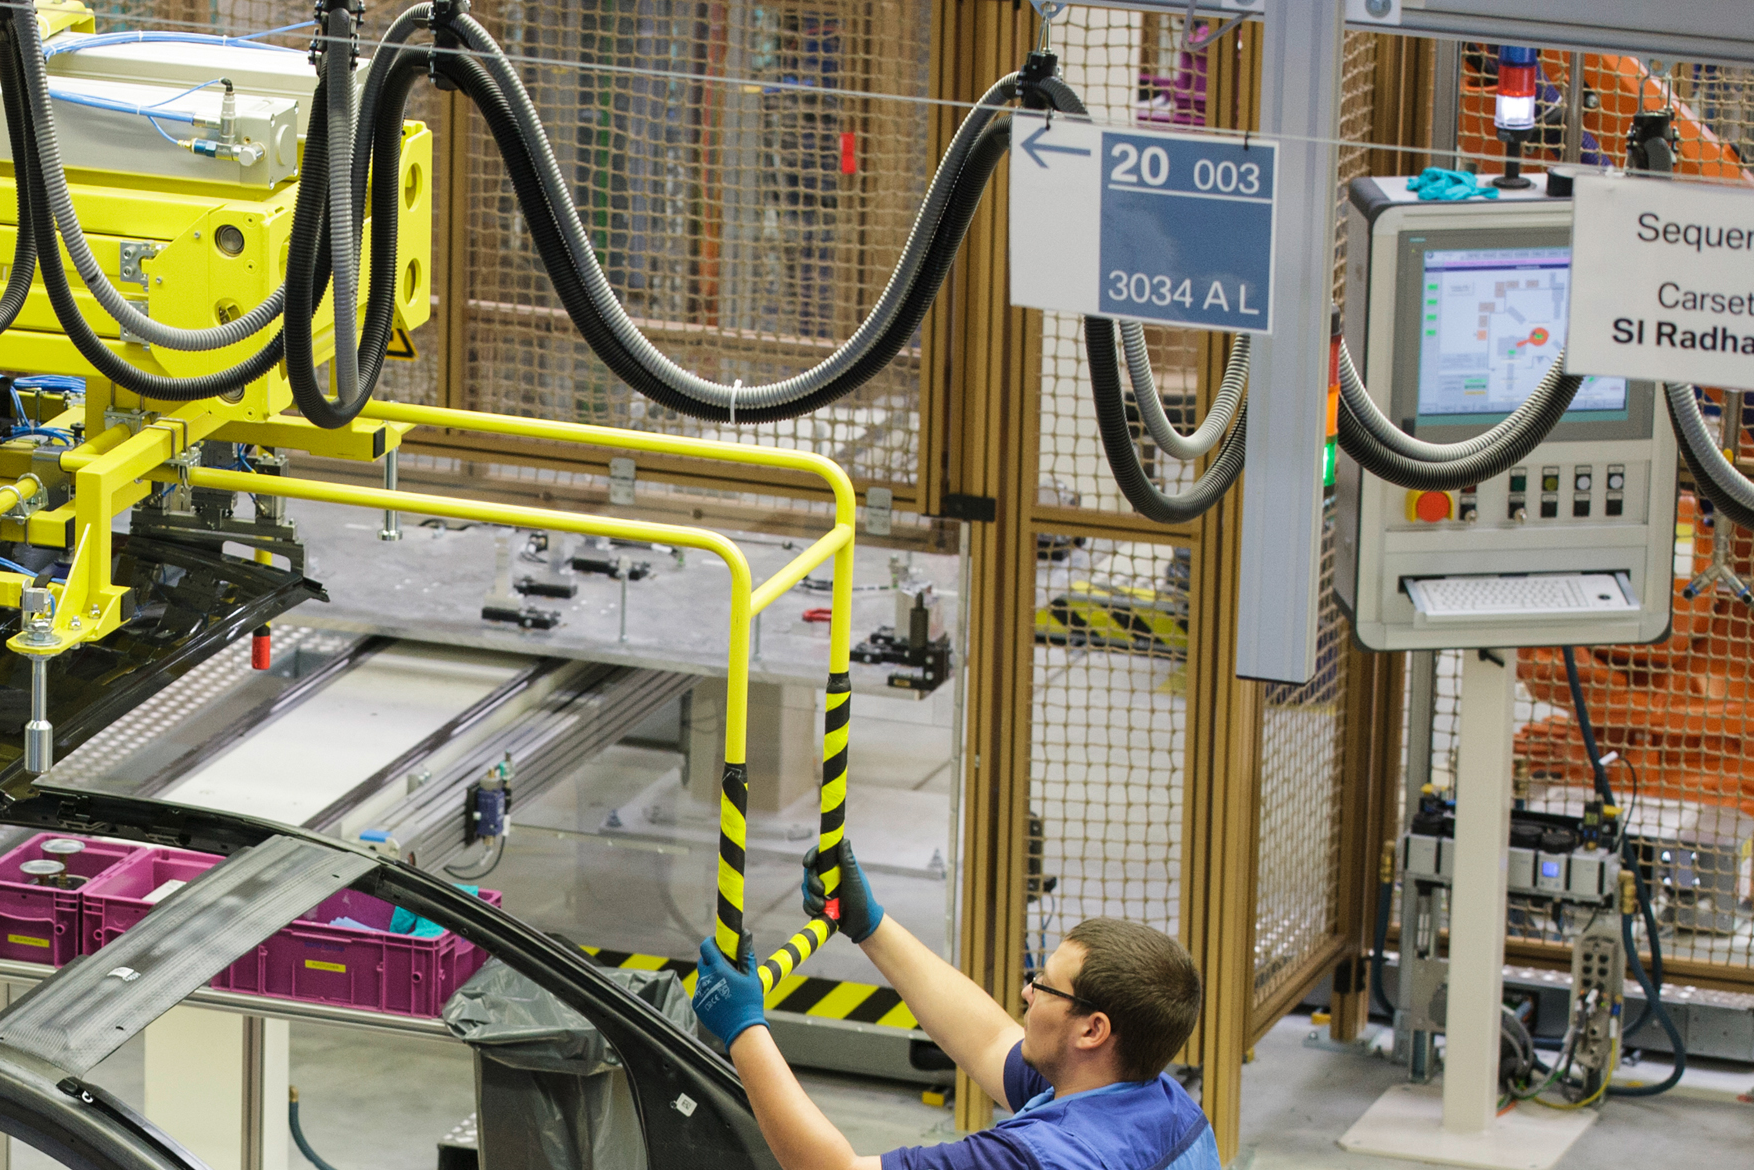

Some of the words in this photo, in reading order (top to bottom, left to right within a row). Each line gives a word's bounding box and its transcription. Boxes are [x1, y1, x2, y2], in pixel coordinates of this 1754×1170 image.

[1110, 142, 1170, 186] 20
[1193, 159, 1260, 194] 003
[1108, 270, 1193, 309] 3034
[1203, 280, 1229, 312] A
[1239, 284, 1260, 315] L
[1612, 317, 1644, 345] SI
[1656, 321, 1754, 355] Radha
